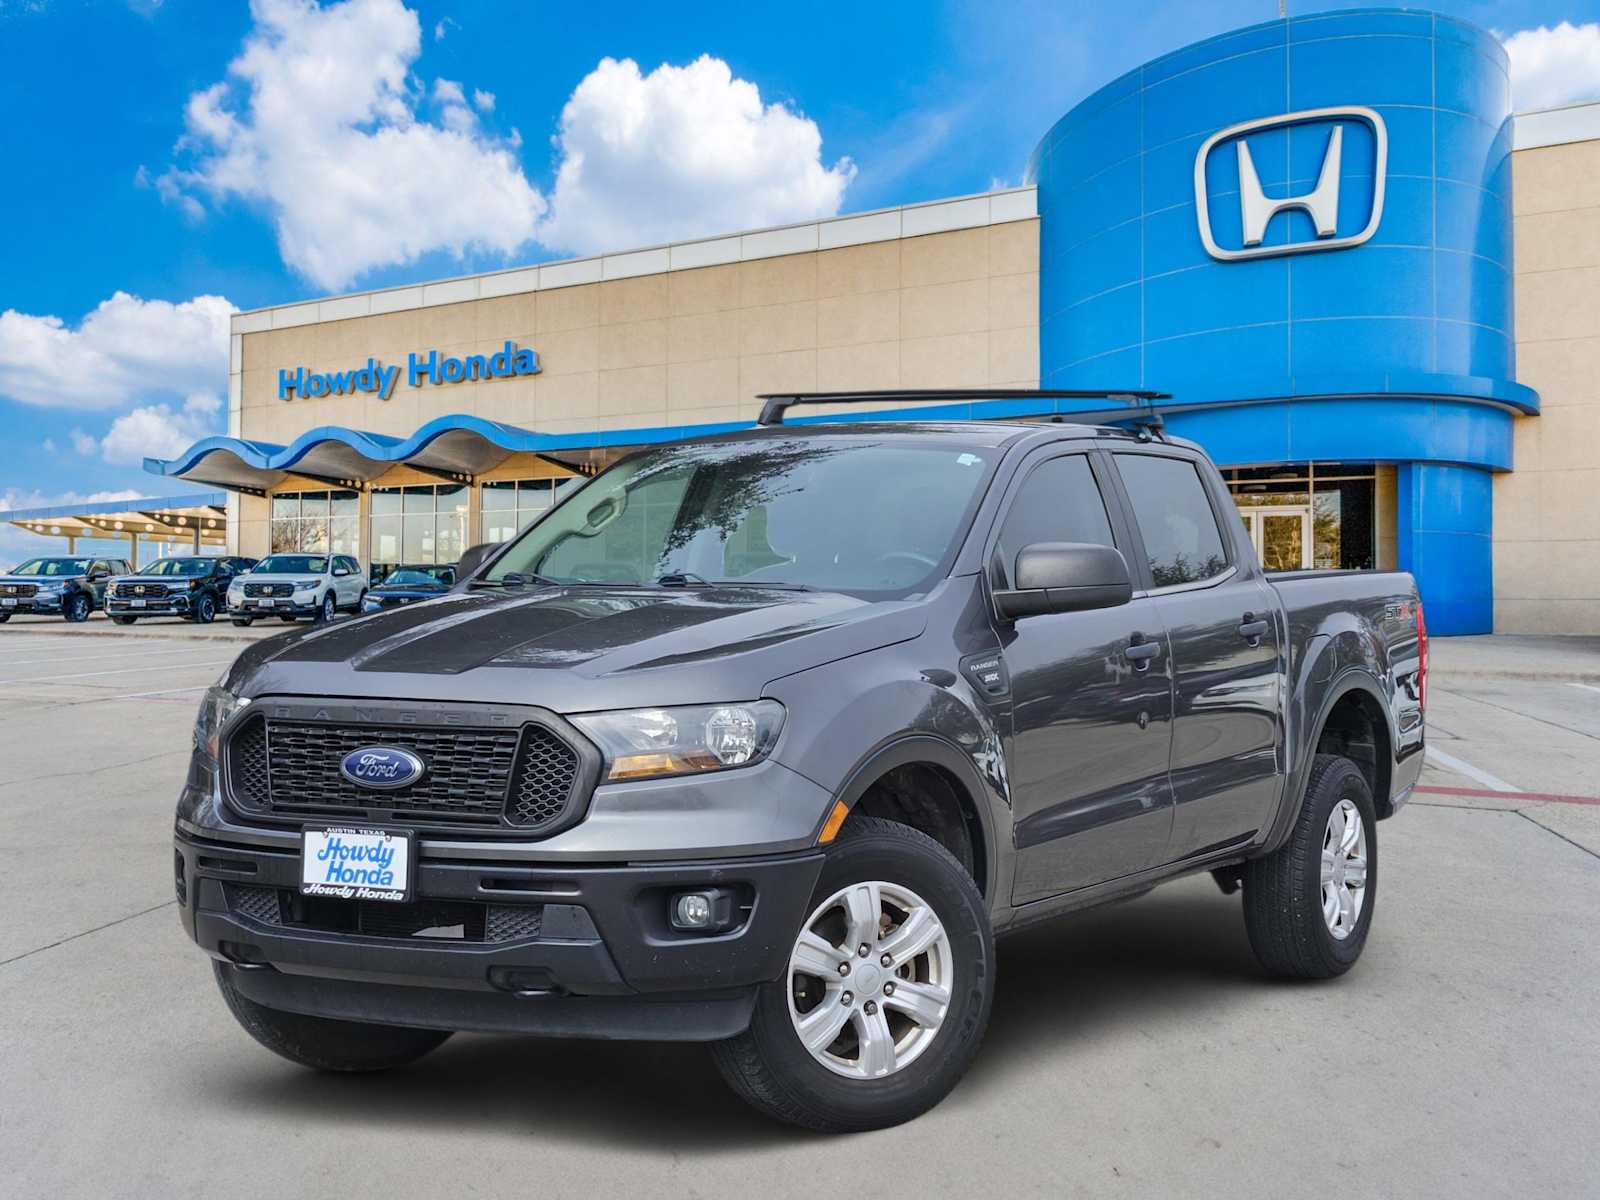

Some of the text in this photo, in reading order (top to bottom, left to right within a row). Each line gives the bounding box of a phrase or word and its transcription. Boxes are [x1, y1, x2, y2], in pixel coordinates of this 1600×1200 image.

[278, 340, 542, 401] Howdy Honda
[273, 706, 508, 725] RANGER
[355, 753, 401, 778] Ford
[326, 827, 356, 835] AUSTIN
[317, 837, 395, 869] Howdy
[325, 860, 394, 886] Honda
[303, 883, 404, 901] Howdy Honda
